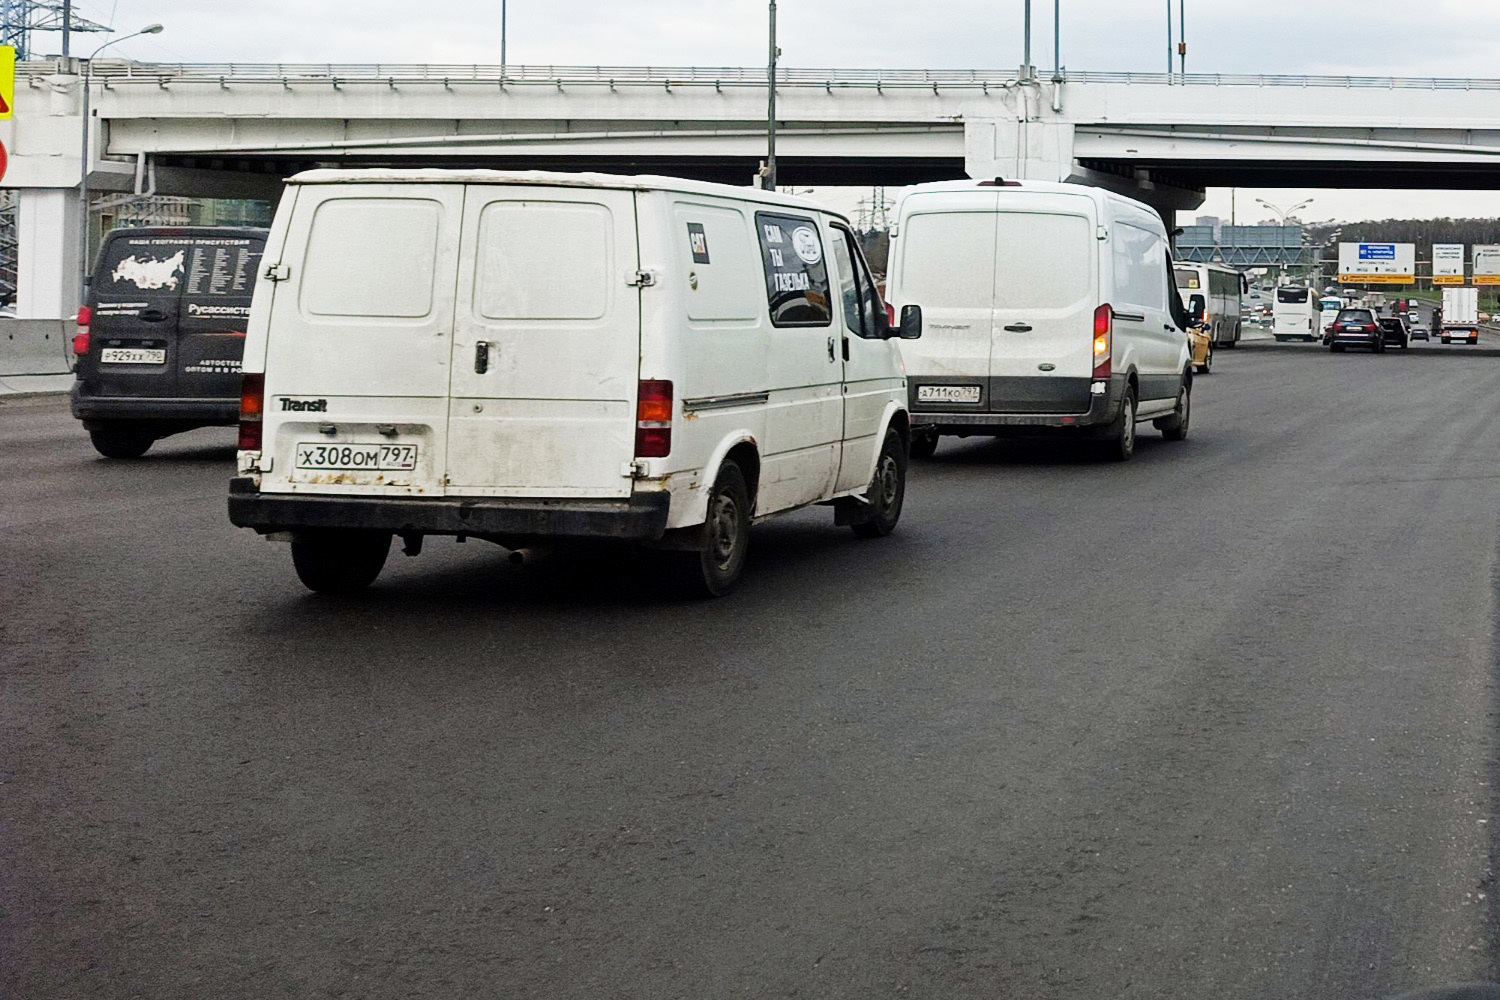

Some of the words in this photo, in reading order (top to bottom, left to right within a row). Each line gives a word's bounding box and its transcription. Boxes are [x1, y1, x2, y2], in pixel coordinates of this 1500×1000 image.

[763, 224, 784, 243] САМ
[769, 248, 784, 267] ТЫ
[774, 272, 810, 291] ГАЗЕЛЬКА
[279, 397, 328, 412] Transit
